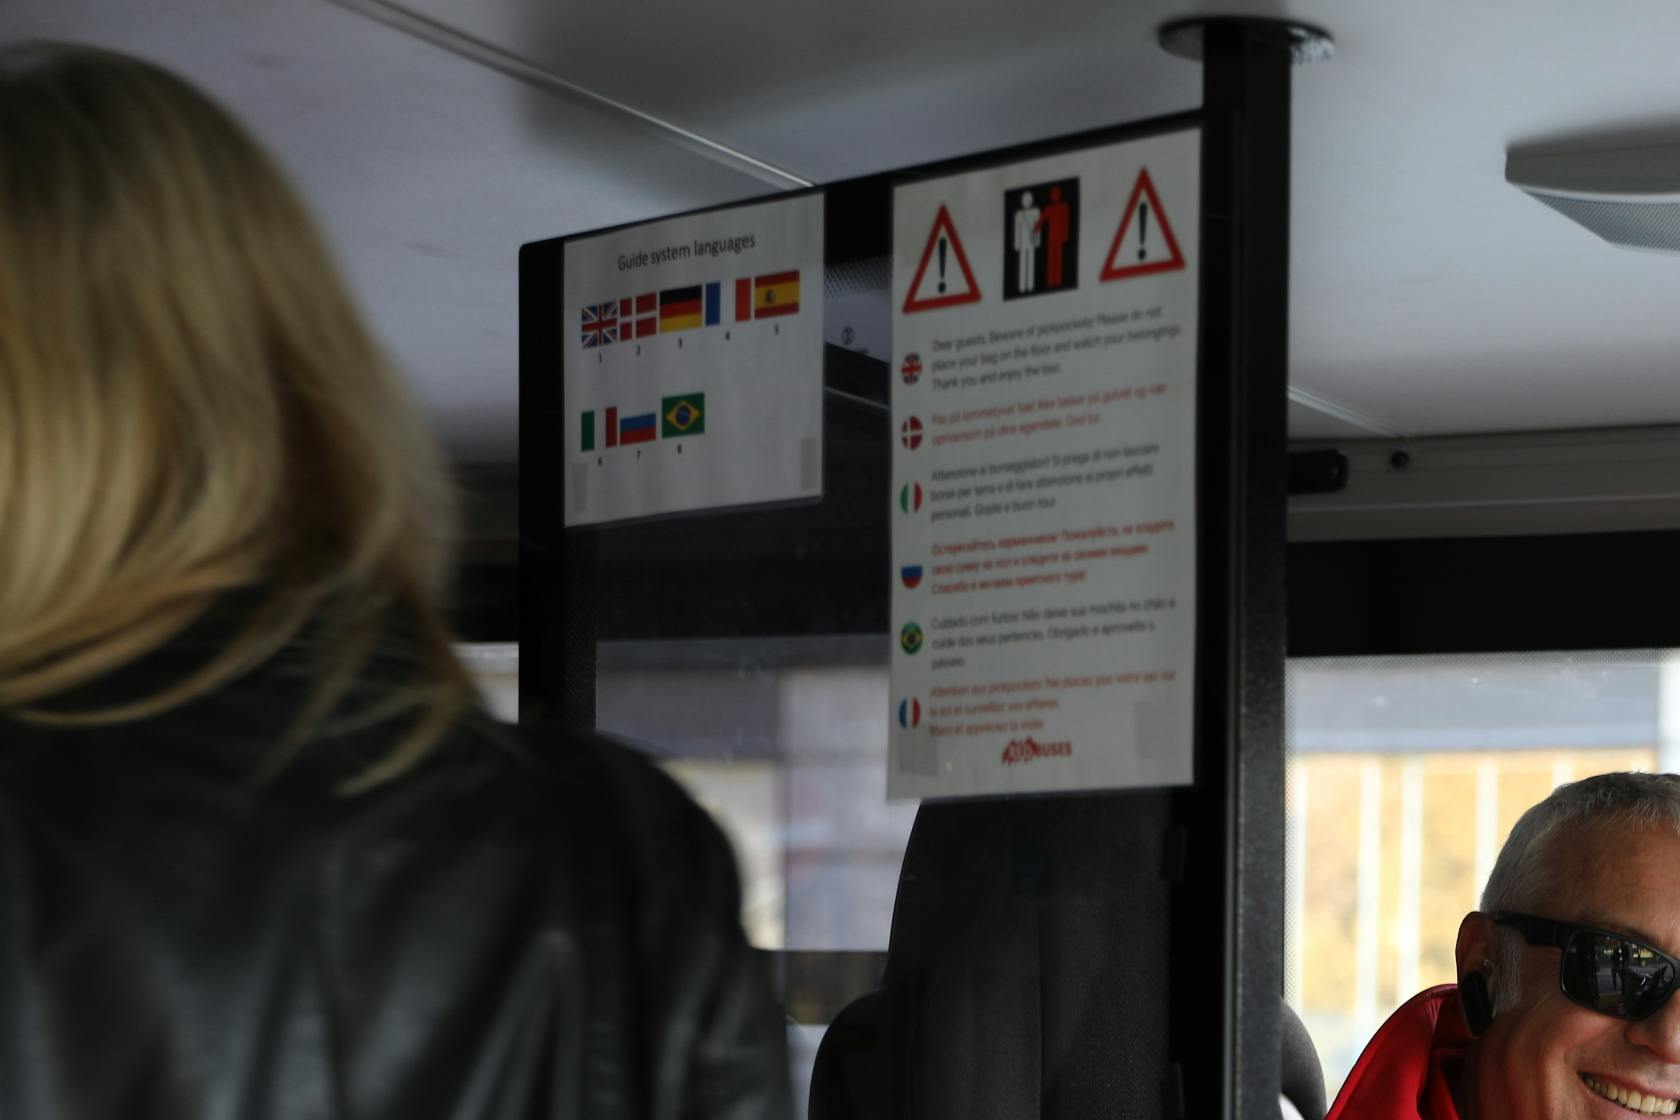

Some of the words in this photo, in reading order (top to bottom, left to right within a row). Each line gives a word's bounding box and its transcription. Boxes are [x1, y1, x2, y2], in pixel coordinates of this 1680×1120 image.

[618, 250, 649, 271] Guide
[650, 244, 690, 267] system
[694, 234, 756, 257] languages
